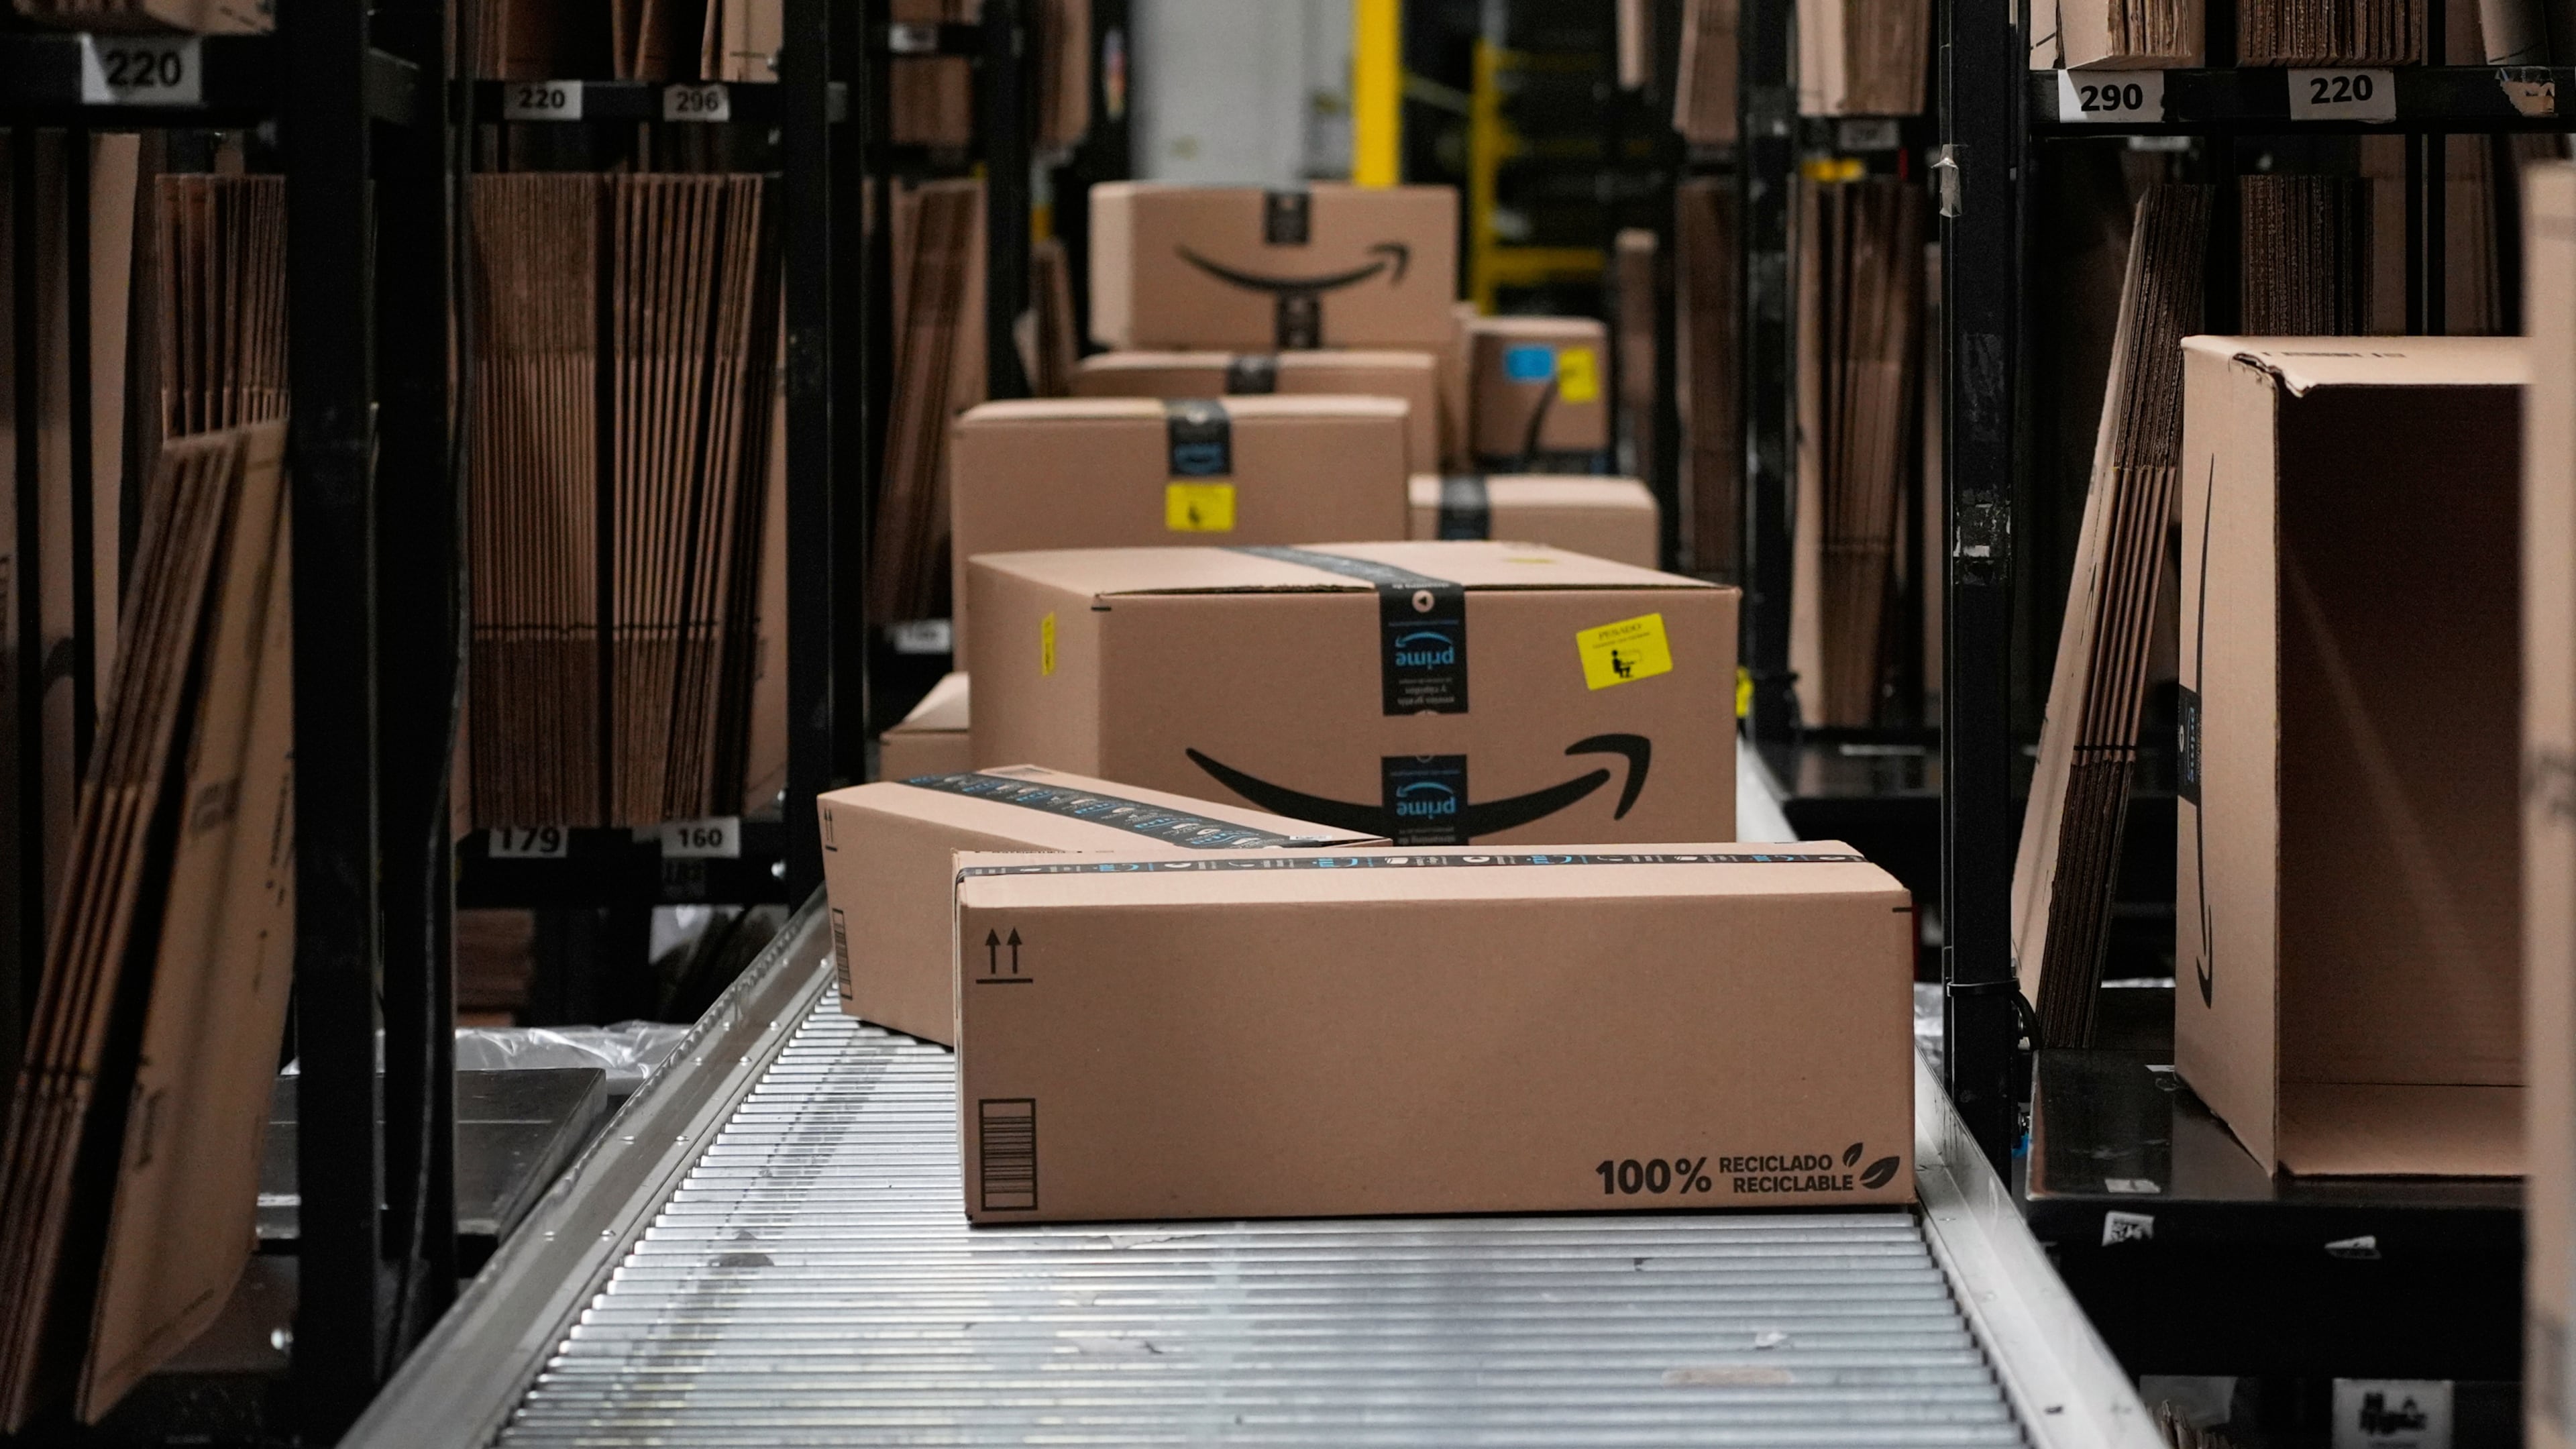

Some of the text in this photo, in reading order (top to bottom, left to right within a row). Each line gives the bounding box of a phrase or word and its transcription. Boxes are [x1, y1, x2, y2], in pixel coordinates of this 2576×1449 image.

[105, 50, 181, 87] 220
[519, 89, 566, 109] 220
[2080, 84, 2143, 111] 290
[2310, 75, 2373, 104] 220
[676, 92, 720, 112] 296
[1395, 646, 1455, 670] prime
[1396, 796, 1457, 820] prime
[498, 826, 559, 852] 179
[679, 828, 722, 848] 160
[1595, 1157, 1712, 1194] 100%
[1720, 1155, 1833, 1173] RECICLADO
[1733, 1175, 1854, 1193] RECICLABLE
